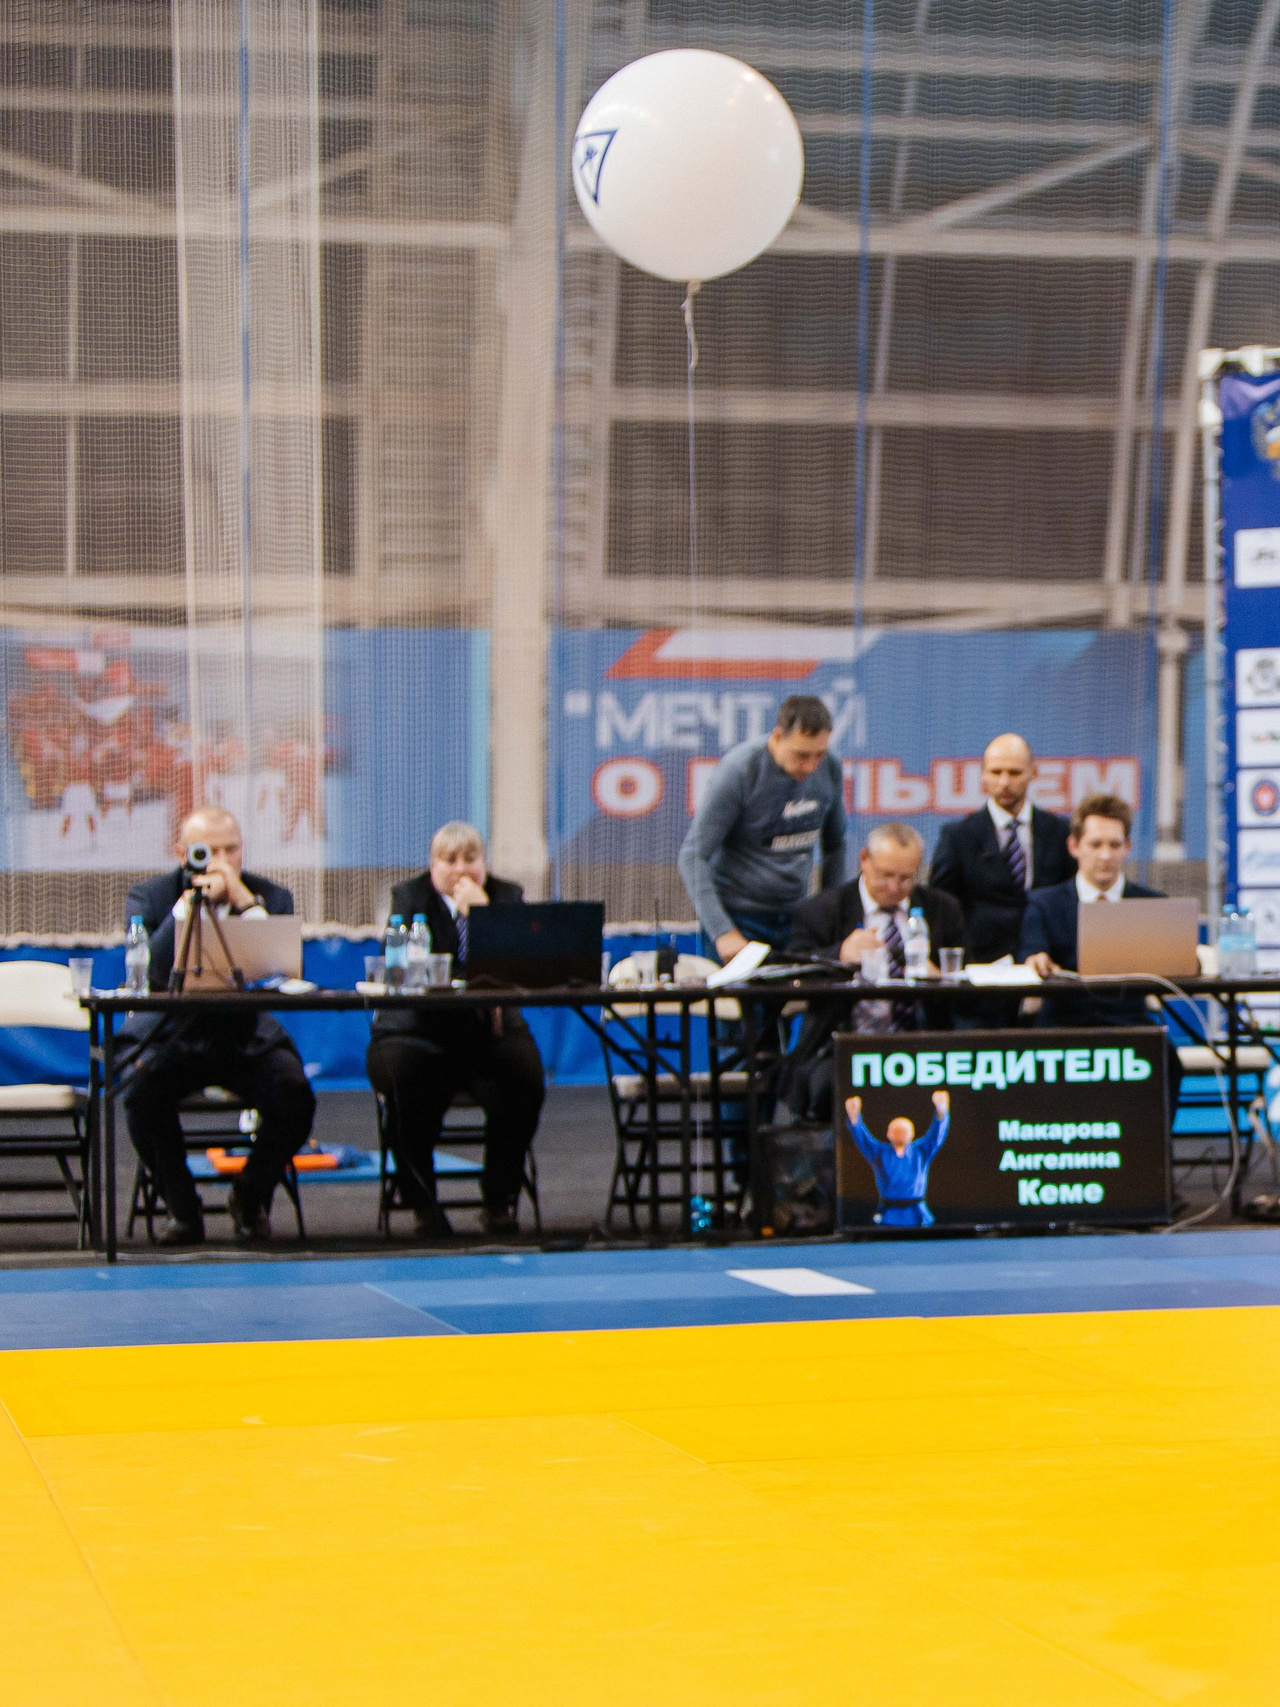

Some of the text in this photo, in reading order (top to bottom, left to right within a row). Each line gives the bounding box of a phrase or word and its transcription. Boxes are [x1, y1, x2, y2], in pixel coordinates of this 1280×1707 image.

[591, 755, 664, 818] О
[851, 1048, 1152, 1091] ПОБЕДИТЕЛЬ
[998, 1119, 1121, 1145] Макарова
[999, 1149, 1121, 1172] Ангелина
